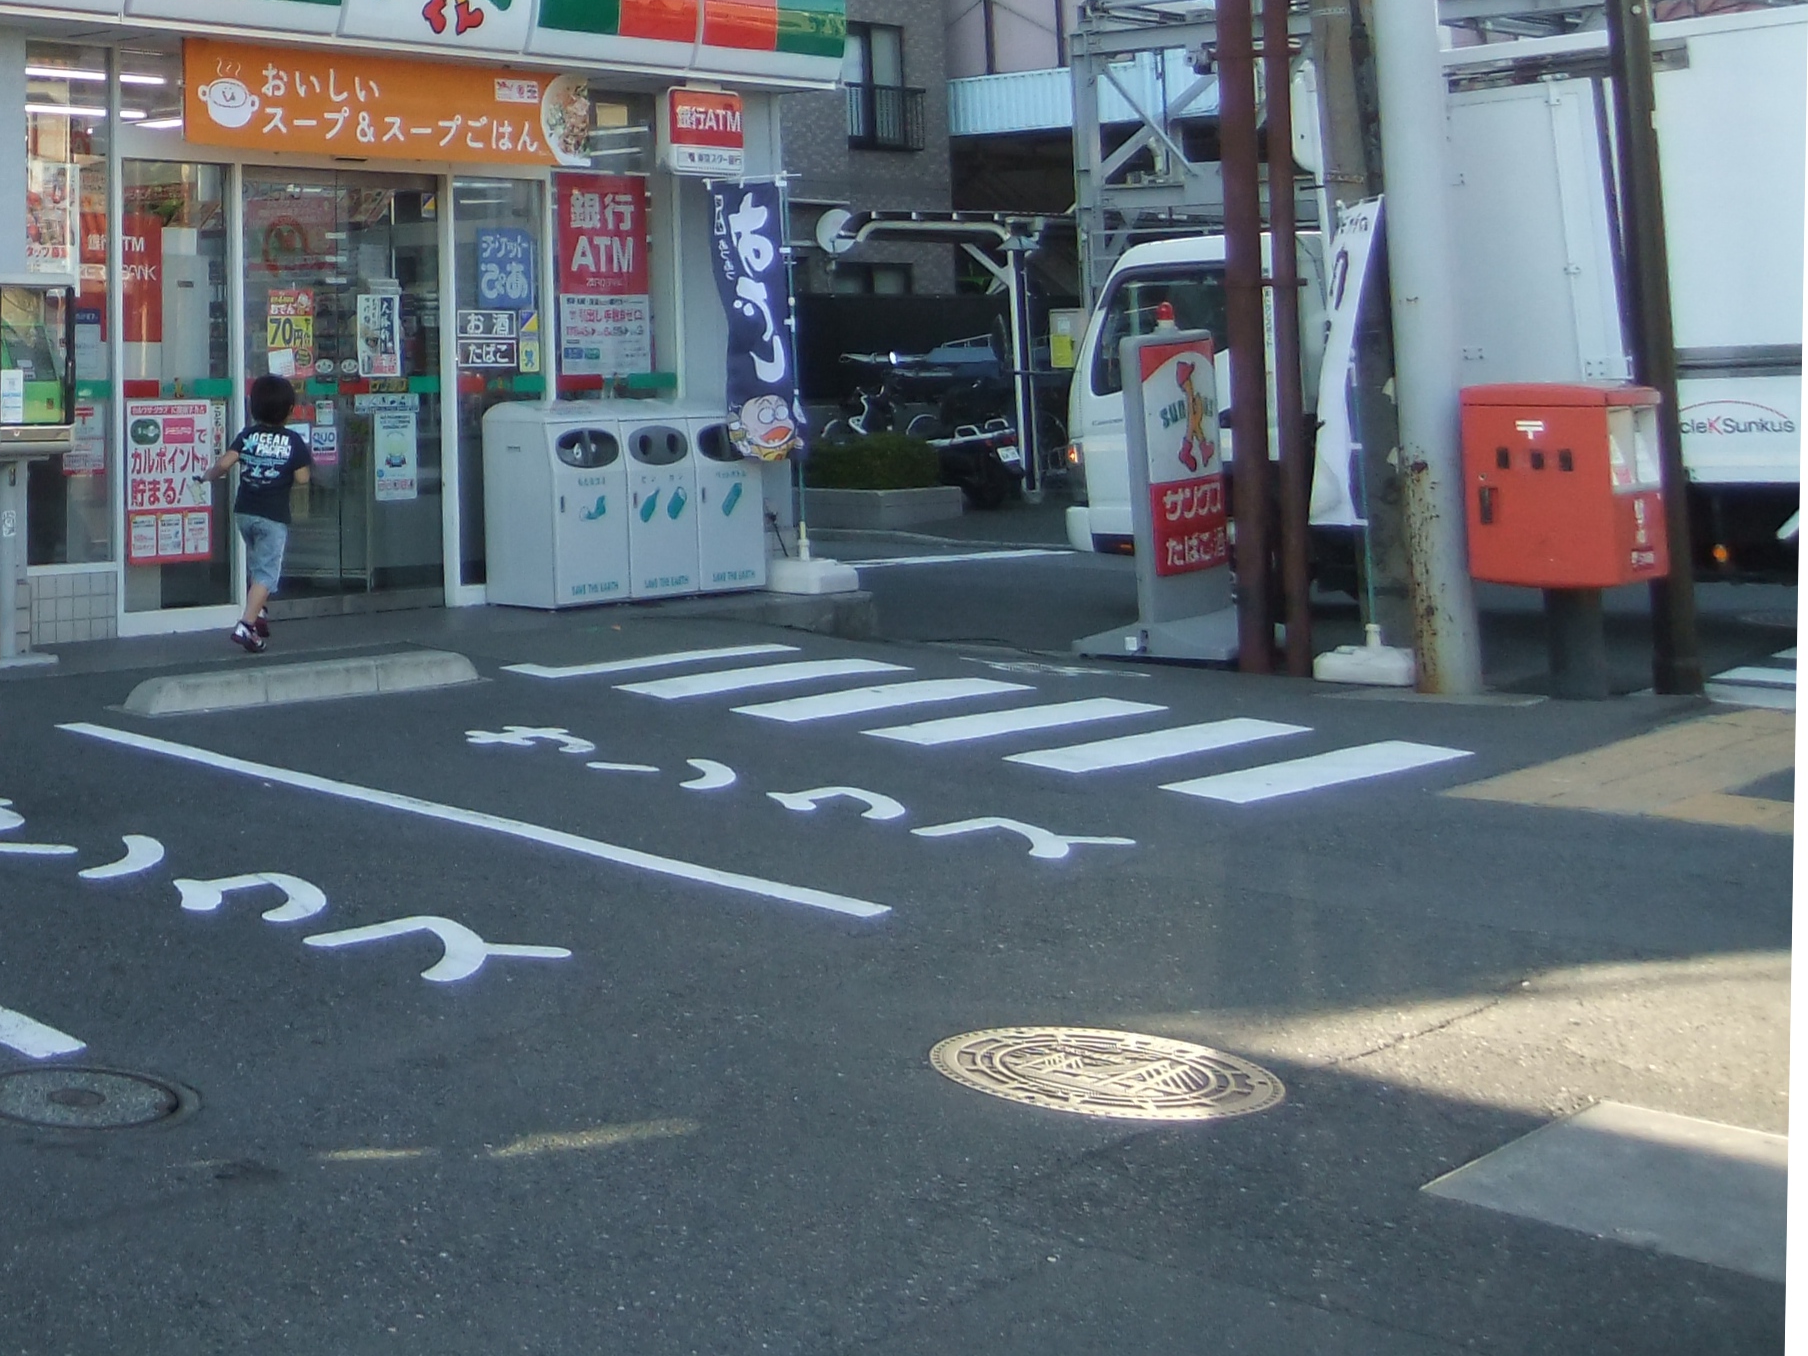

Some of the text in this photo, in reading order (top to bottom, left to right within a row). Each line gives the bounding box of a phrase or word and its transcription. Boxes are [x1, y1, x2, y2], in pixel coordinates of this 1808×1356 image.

[260, 62, 381, 103] おいしい
[261, 104, 539, 155] スープ&スープごはん
[676, 105, 742, 132] 銀行ATM
[570, 192, 635, 231] 銀行
[481, 234, 529, 259] チケット
[571, 235, 634, 273] ATM
[480, 260, 529, 300] ぴあ
[466, 312, 510, 336] お酒
[468, 342, 510, 364] たばこ
[253, 431, 290, 446] OCEAN
[1681, 416, 1795, 436] cleKSunkus
[130, 477, 187, 507] 貯まる!
